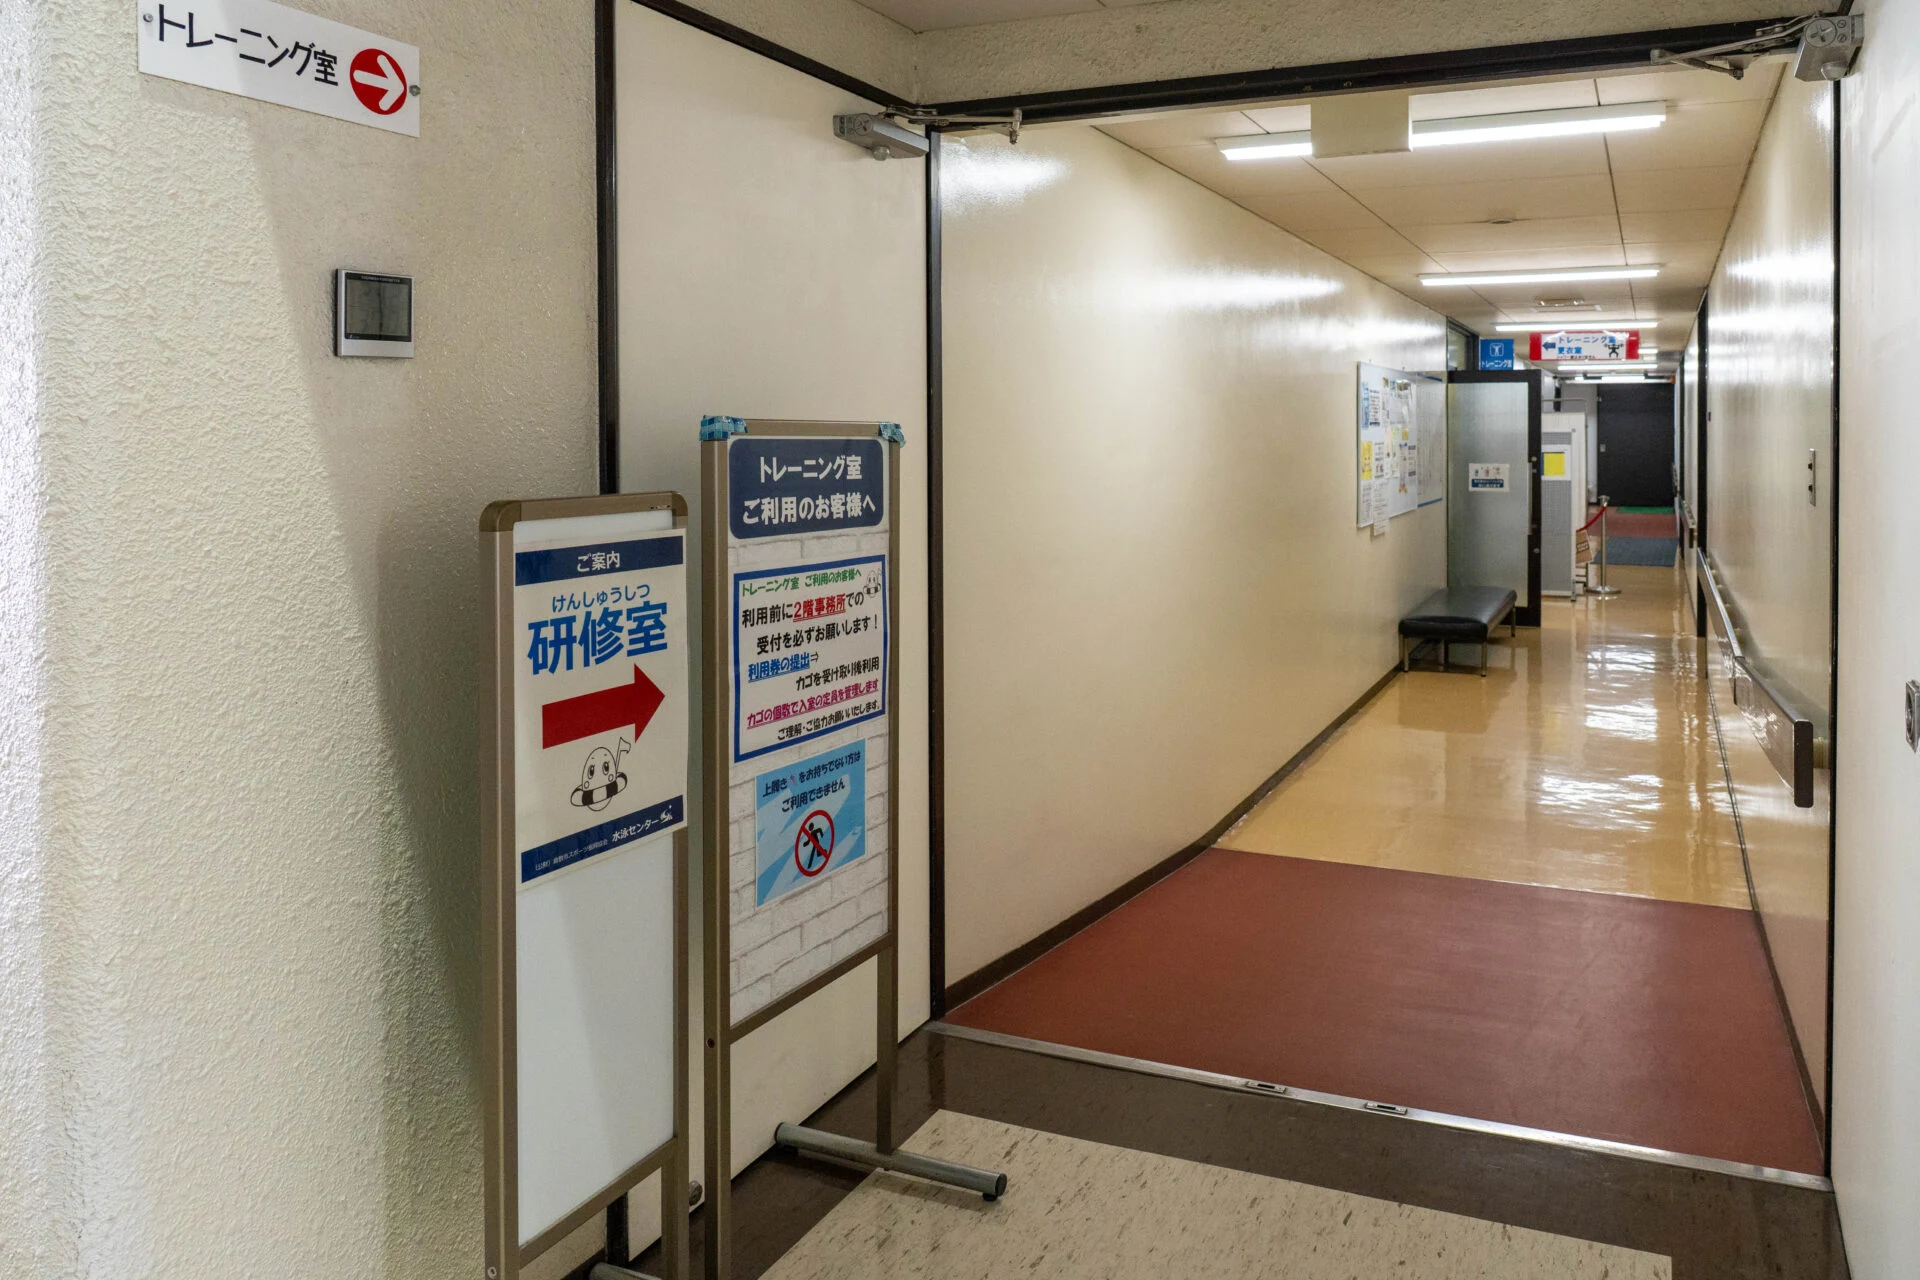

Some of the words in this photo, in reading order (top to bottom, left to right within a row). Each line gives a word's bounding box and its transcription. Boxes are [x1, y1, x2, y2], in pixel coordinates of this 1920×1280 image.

[158, 3, 339, 87] トレーニング室
[760, 454, 863, 484] トレーニング室
[742, 492, 876, 526] ご利用のお客様へ
[576, 550, 621, 573] ご案内
[551, 583, 651, 613] けんしゅうしつ
[742, 577, 800, 597] トレーニング室
[804, 567, 862, 587] ご利用のお客様へ
[527, 600, 668, 676] 研修室
[795, 656, 880, 691] カゴを受け取り後利用
[747, 679, 879, 728] カゴの個数で入室の定員を管理します
[781, 778, 845, 813] ご利用できません
[611, 819, 660, 842] 水泳センター
